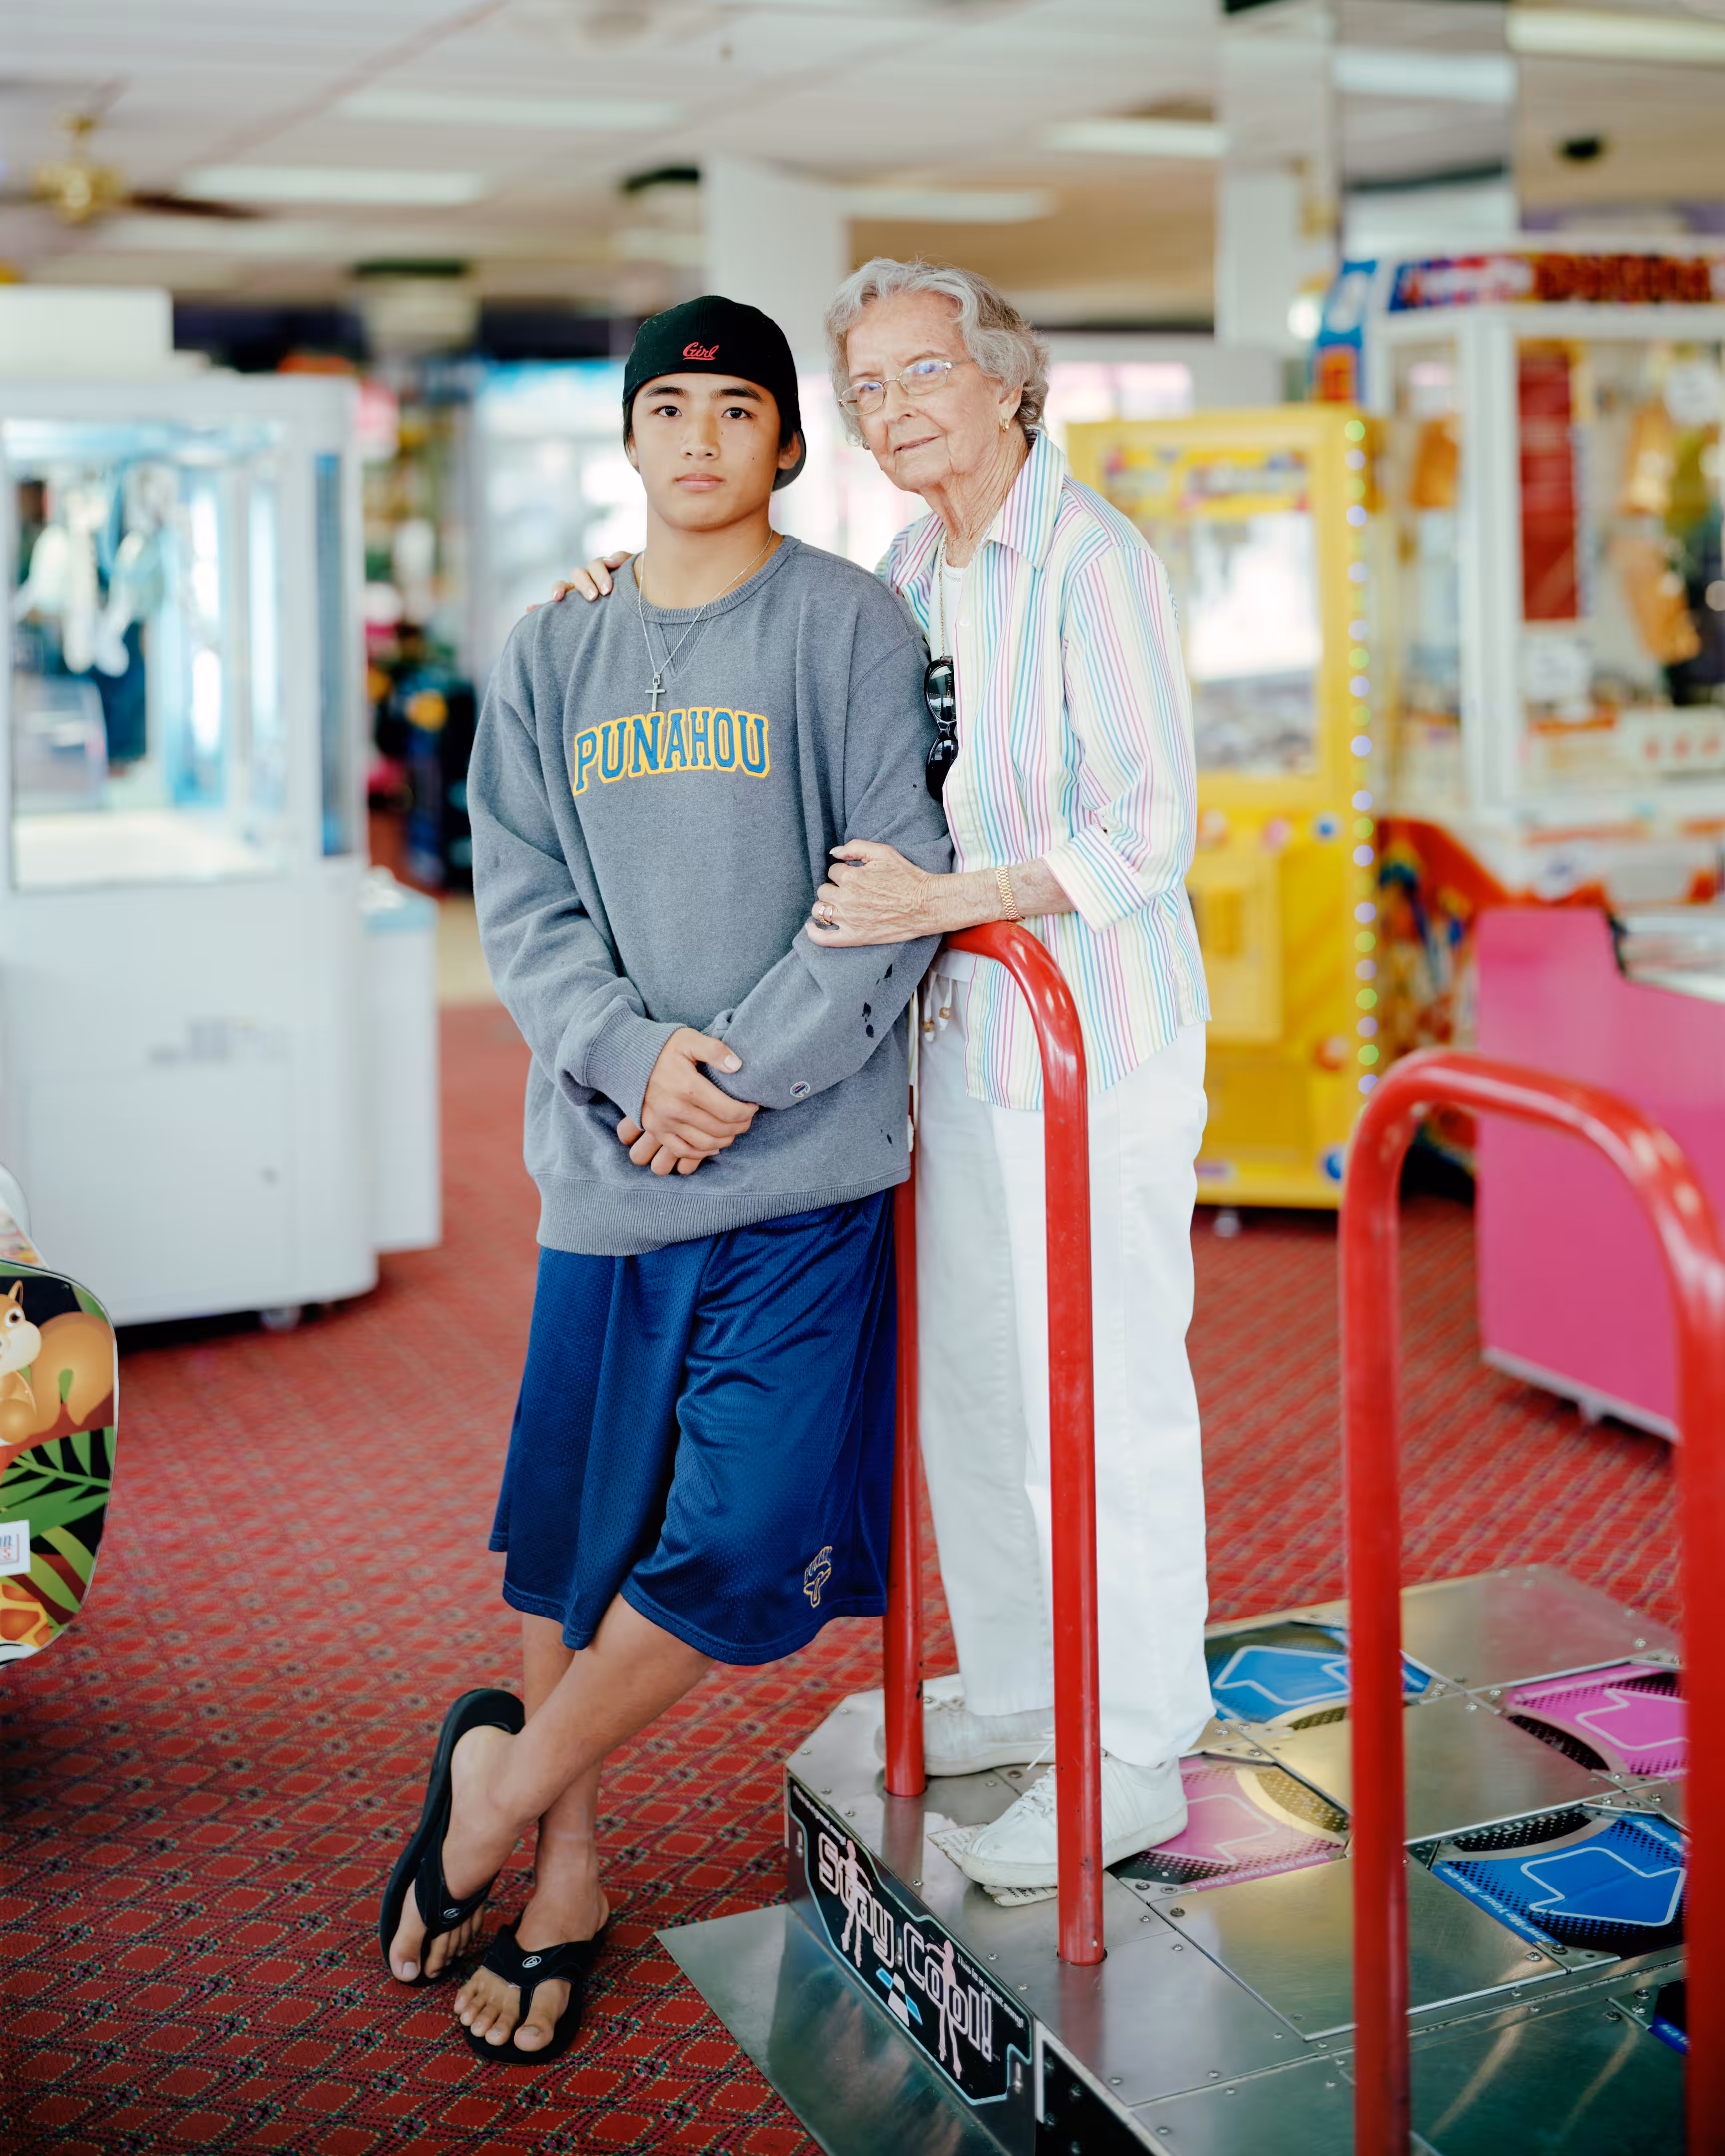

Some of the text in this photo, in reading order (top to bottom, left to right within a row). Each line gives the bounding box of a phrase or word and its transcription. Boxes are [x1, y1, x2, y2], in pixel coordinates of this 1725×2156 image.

[683, 342, 719, 360] Girl
[573, 707, 770, 796] PUNAHOU
[1233, 1868, 1270, 1881] Your
[1442, 1867, 1482, 1893] Moves
[1478, 1894, 1509, 1914] Your
[818, 1832, 992, 2062] Stay Cool!
[957, 1953, 971, 1975] This
[972, 1968, 979, 1981] is
[979, 1977, 984, 1987] a
[984, 1983, 1004, 2007] great
